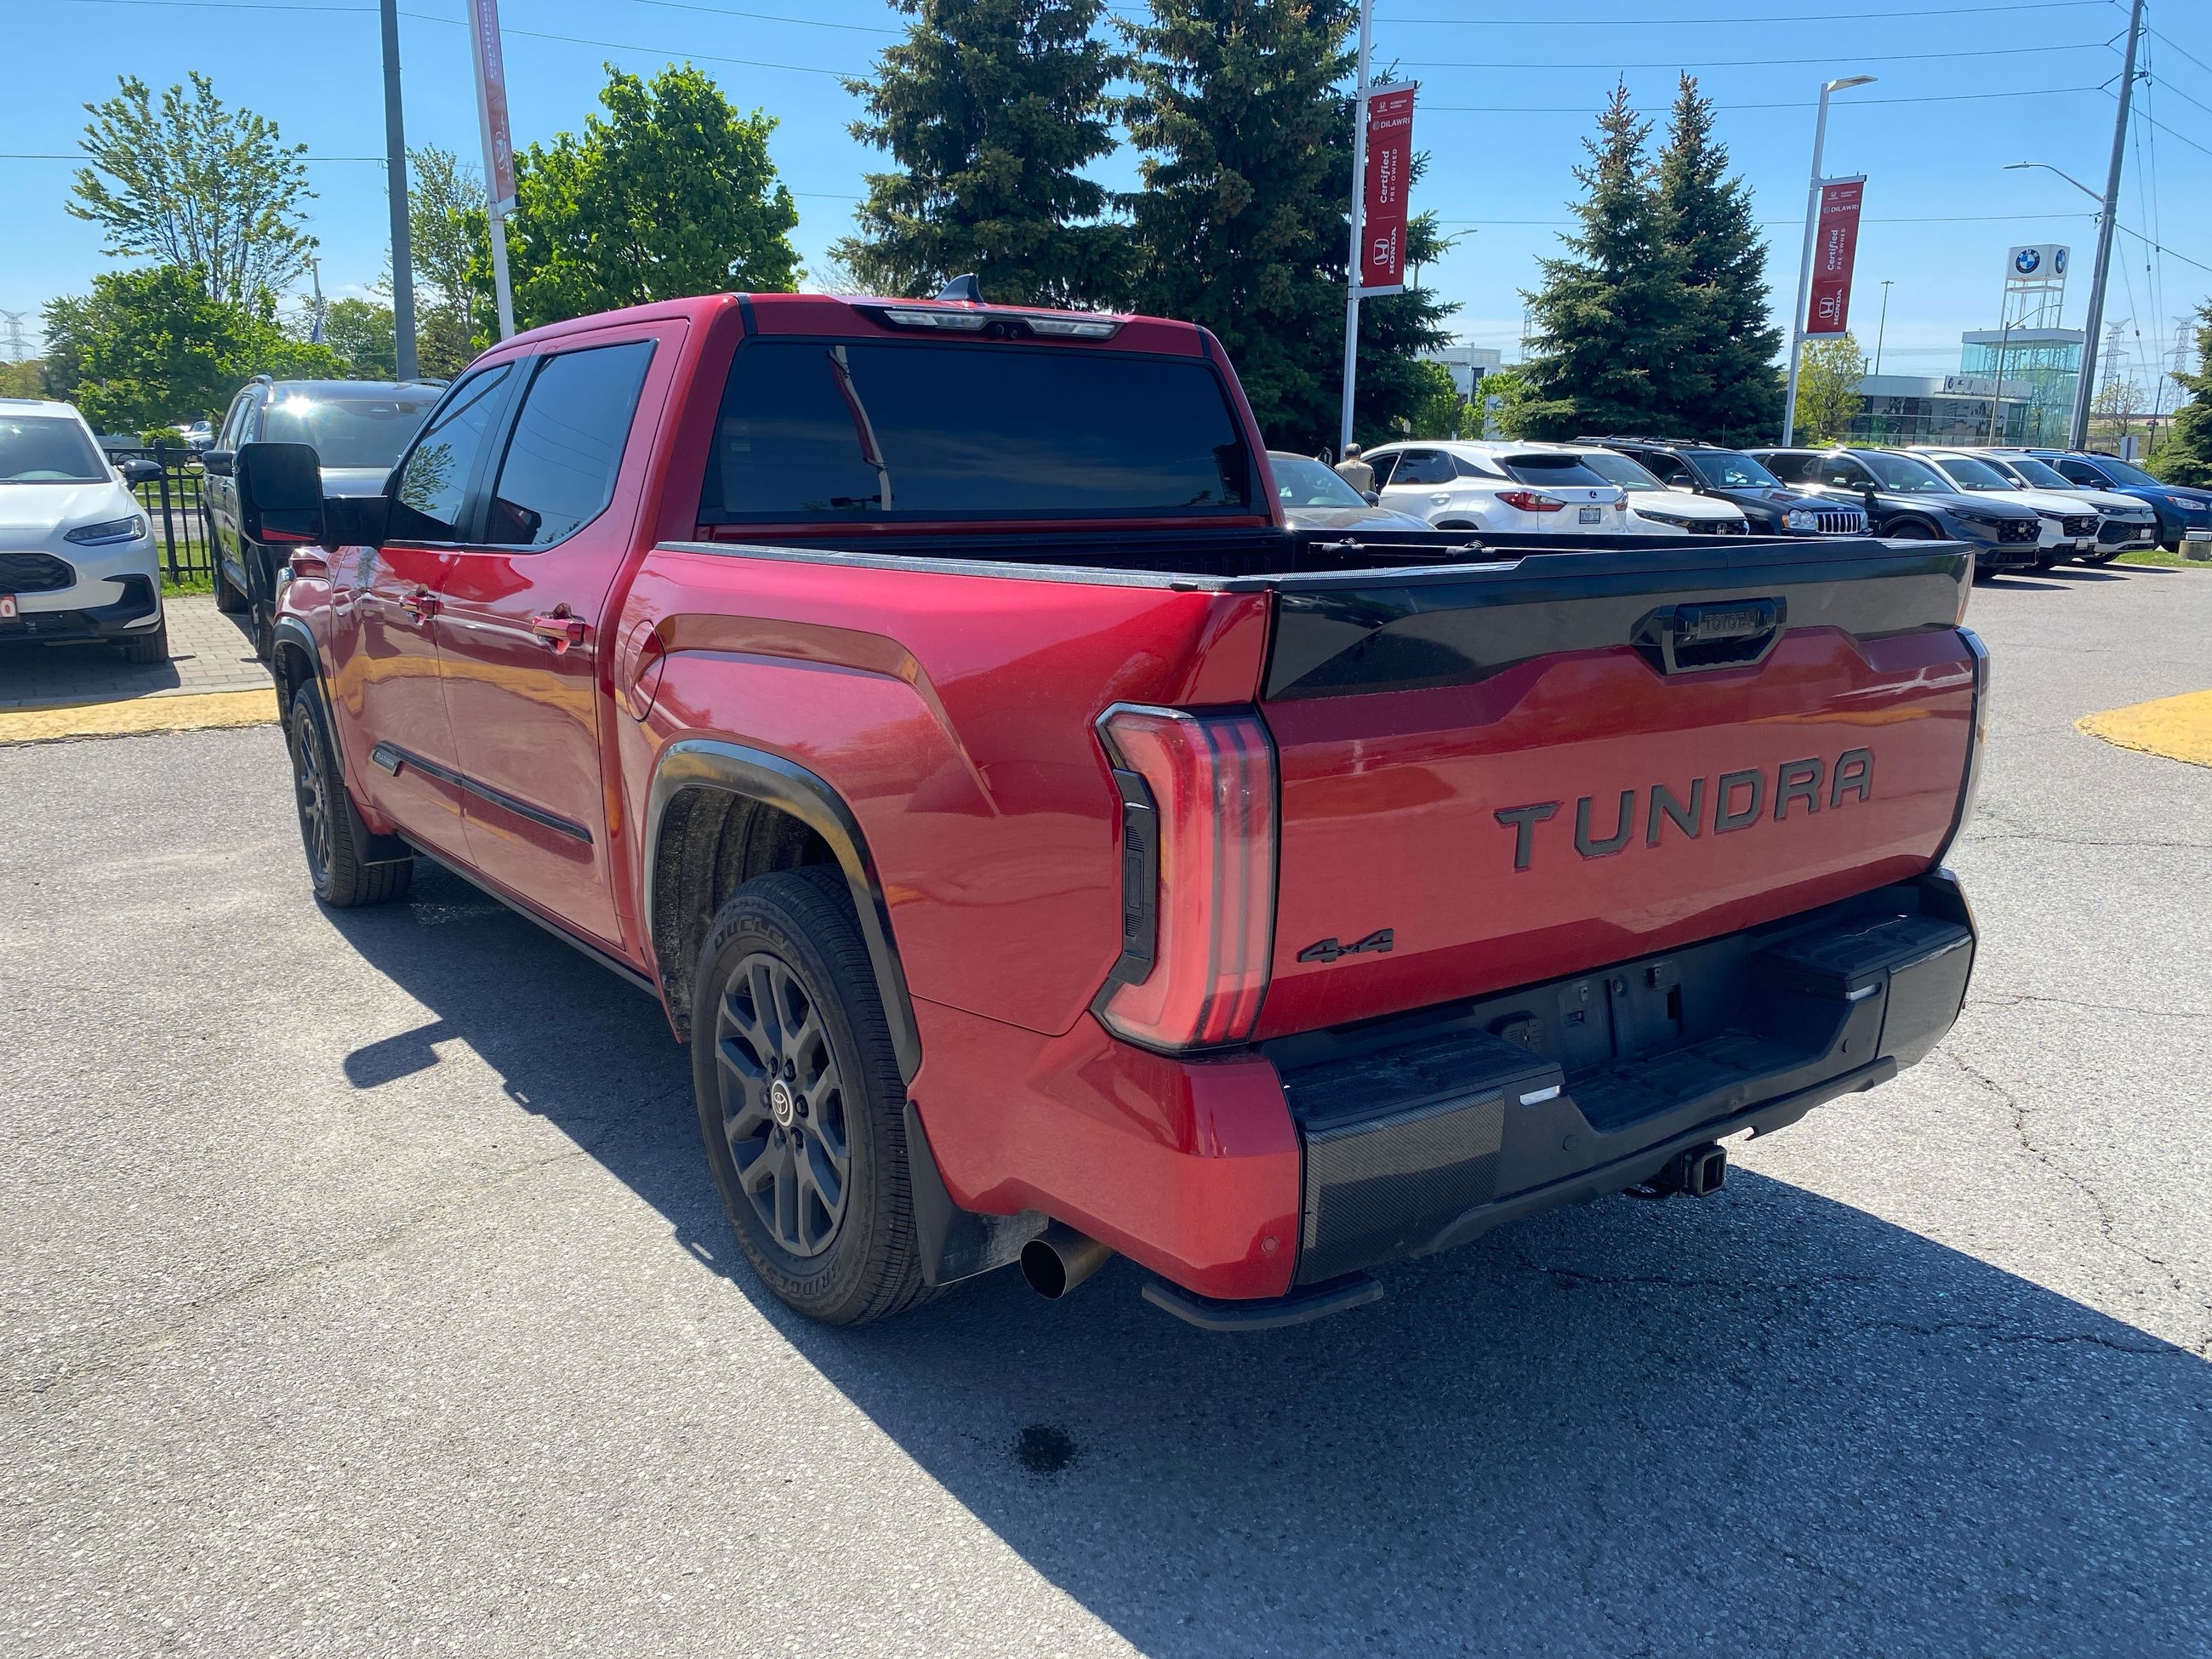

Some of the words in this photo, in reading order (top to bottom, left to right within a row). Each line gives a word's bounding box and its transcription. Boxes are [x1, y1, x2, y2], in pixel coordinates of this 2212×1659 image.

[1381, 117, 1411, 129] DILAWRI
[1380, 151, 1390, 203] Certified
[1389, 149, 1398, 202] PRE-OWNED
[1831, 203, 1860, 213] DILAWRI
[1827, 229, 1839, 271] Certified
[1833, 288, 1843, 326] HONDA
[1704, 609, 1757, 631] TOYOTA
[1493, 746, 1873, 873] TUNDRA
